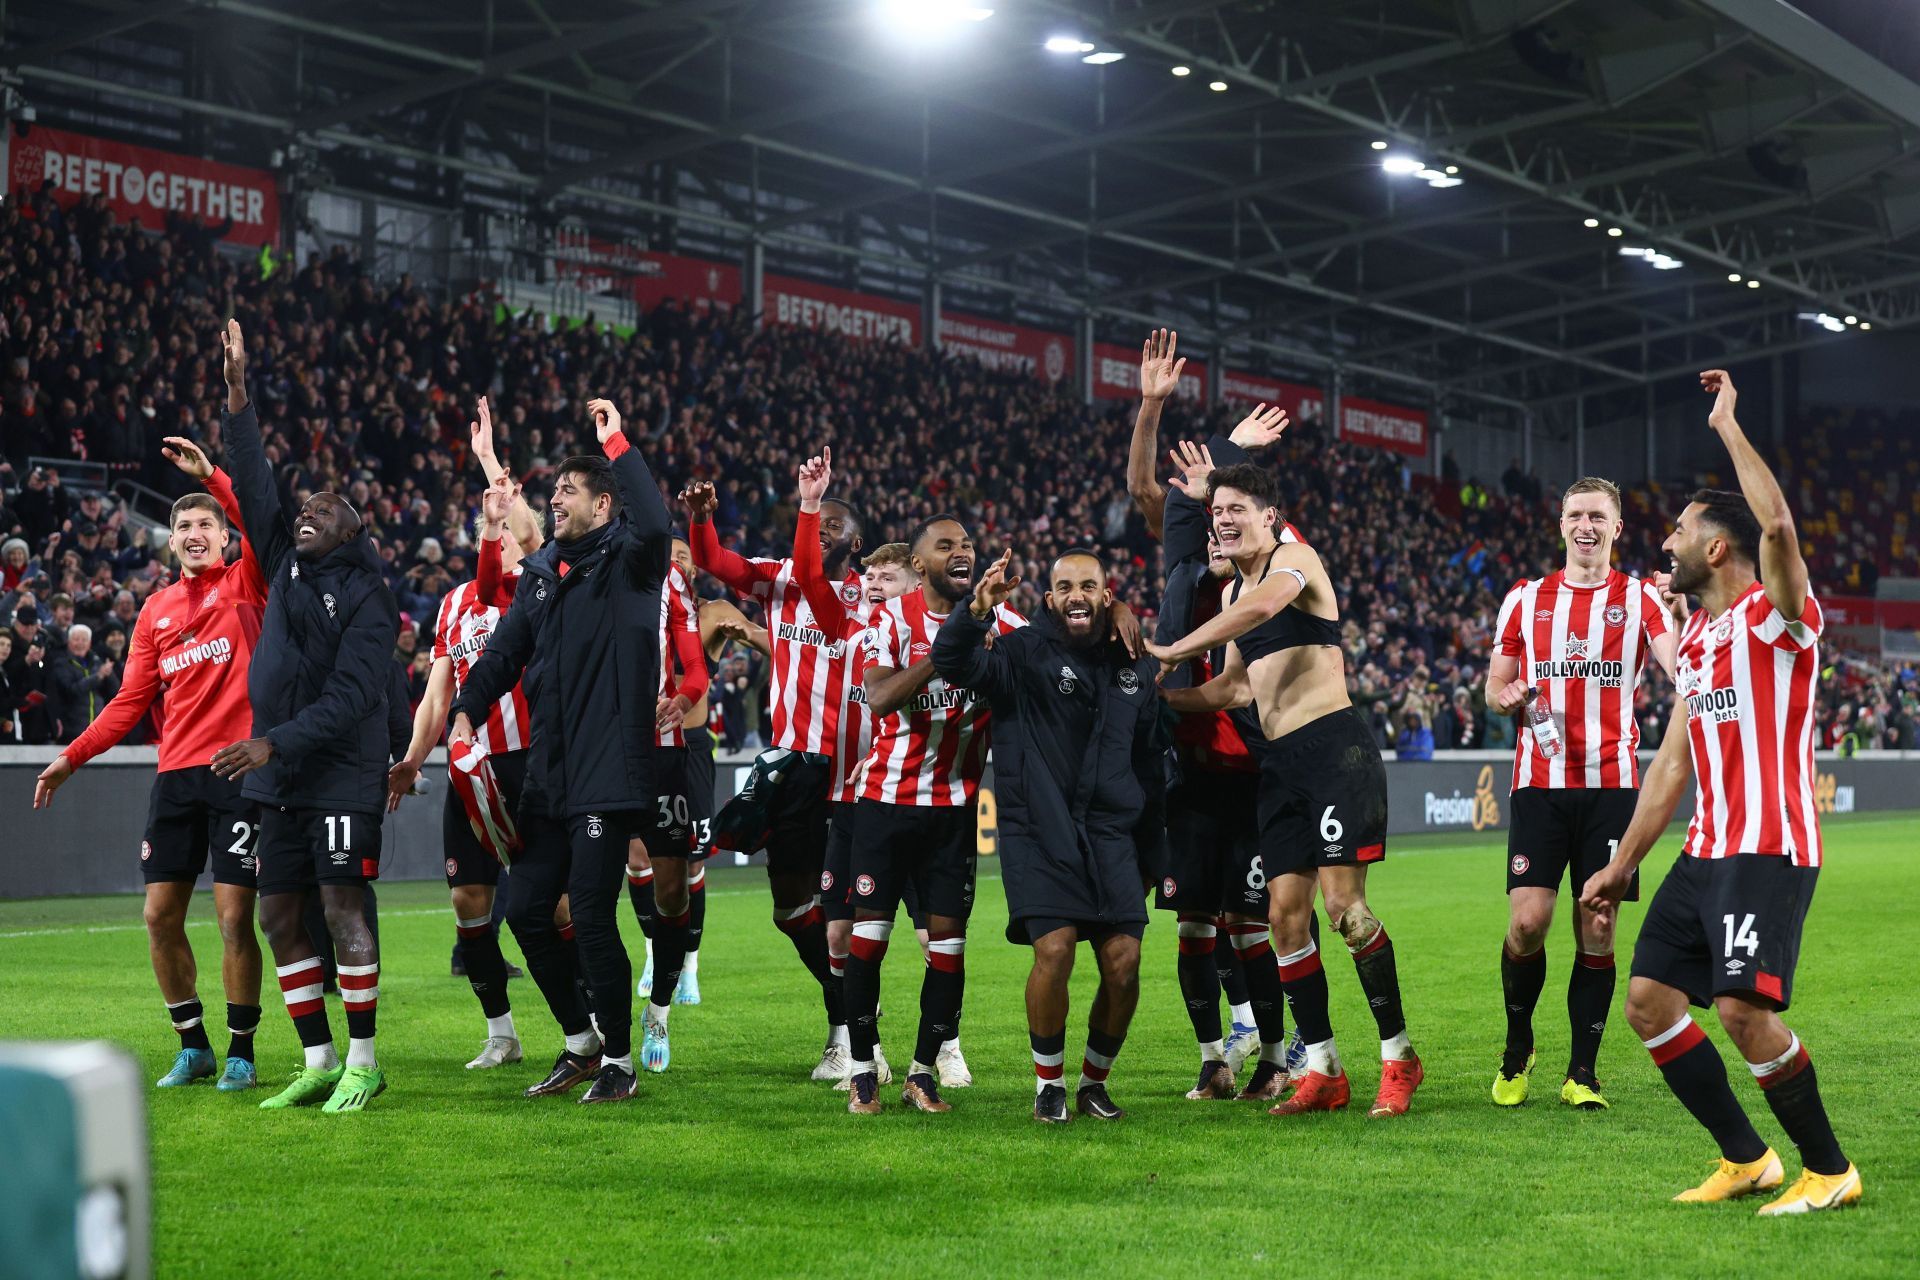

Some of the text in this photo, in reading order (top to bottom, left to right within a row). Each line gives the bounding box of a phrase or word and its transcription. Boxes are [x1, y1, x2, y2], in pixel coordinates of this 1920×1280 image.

[778, 622, 825, 647] HOLLYW
[161, 636, 231, 675] HOLLYWOOD
[212, 653, 232, 665] bets
[1535, 661, 1623, 679] HOLLYWOOD
[1600, 677, 1621, 687] bets
[911, 688, 978, 712] HOLLYWO
[1714, 709, 1739, 722] bets
[657, 794, 689, 829] 30
[1320, 805, 1344, 842] 6
[324, 815, 351, 851] 11
[1722, 913, 1760, 958] 14
